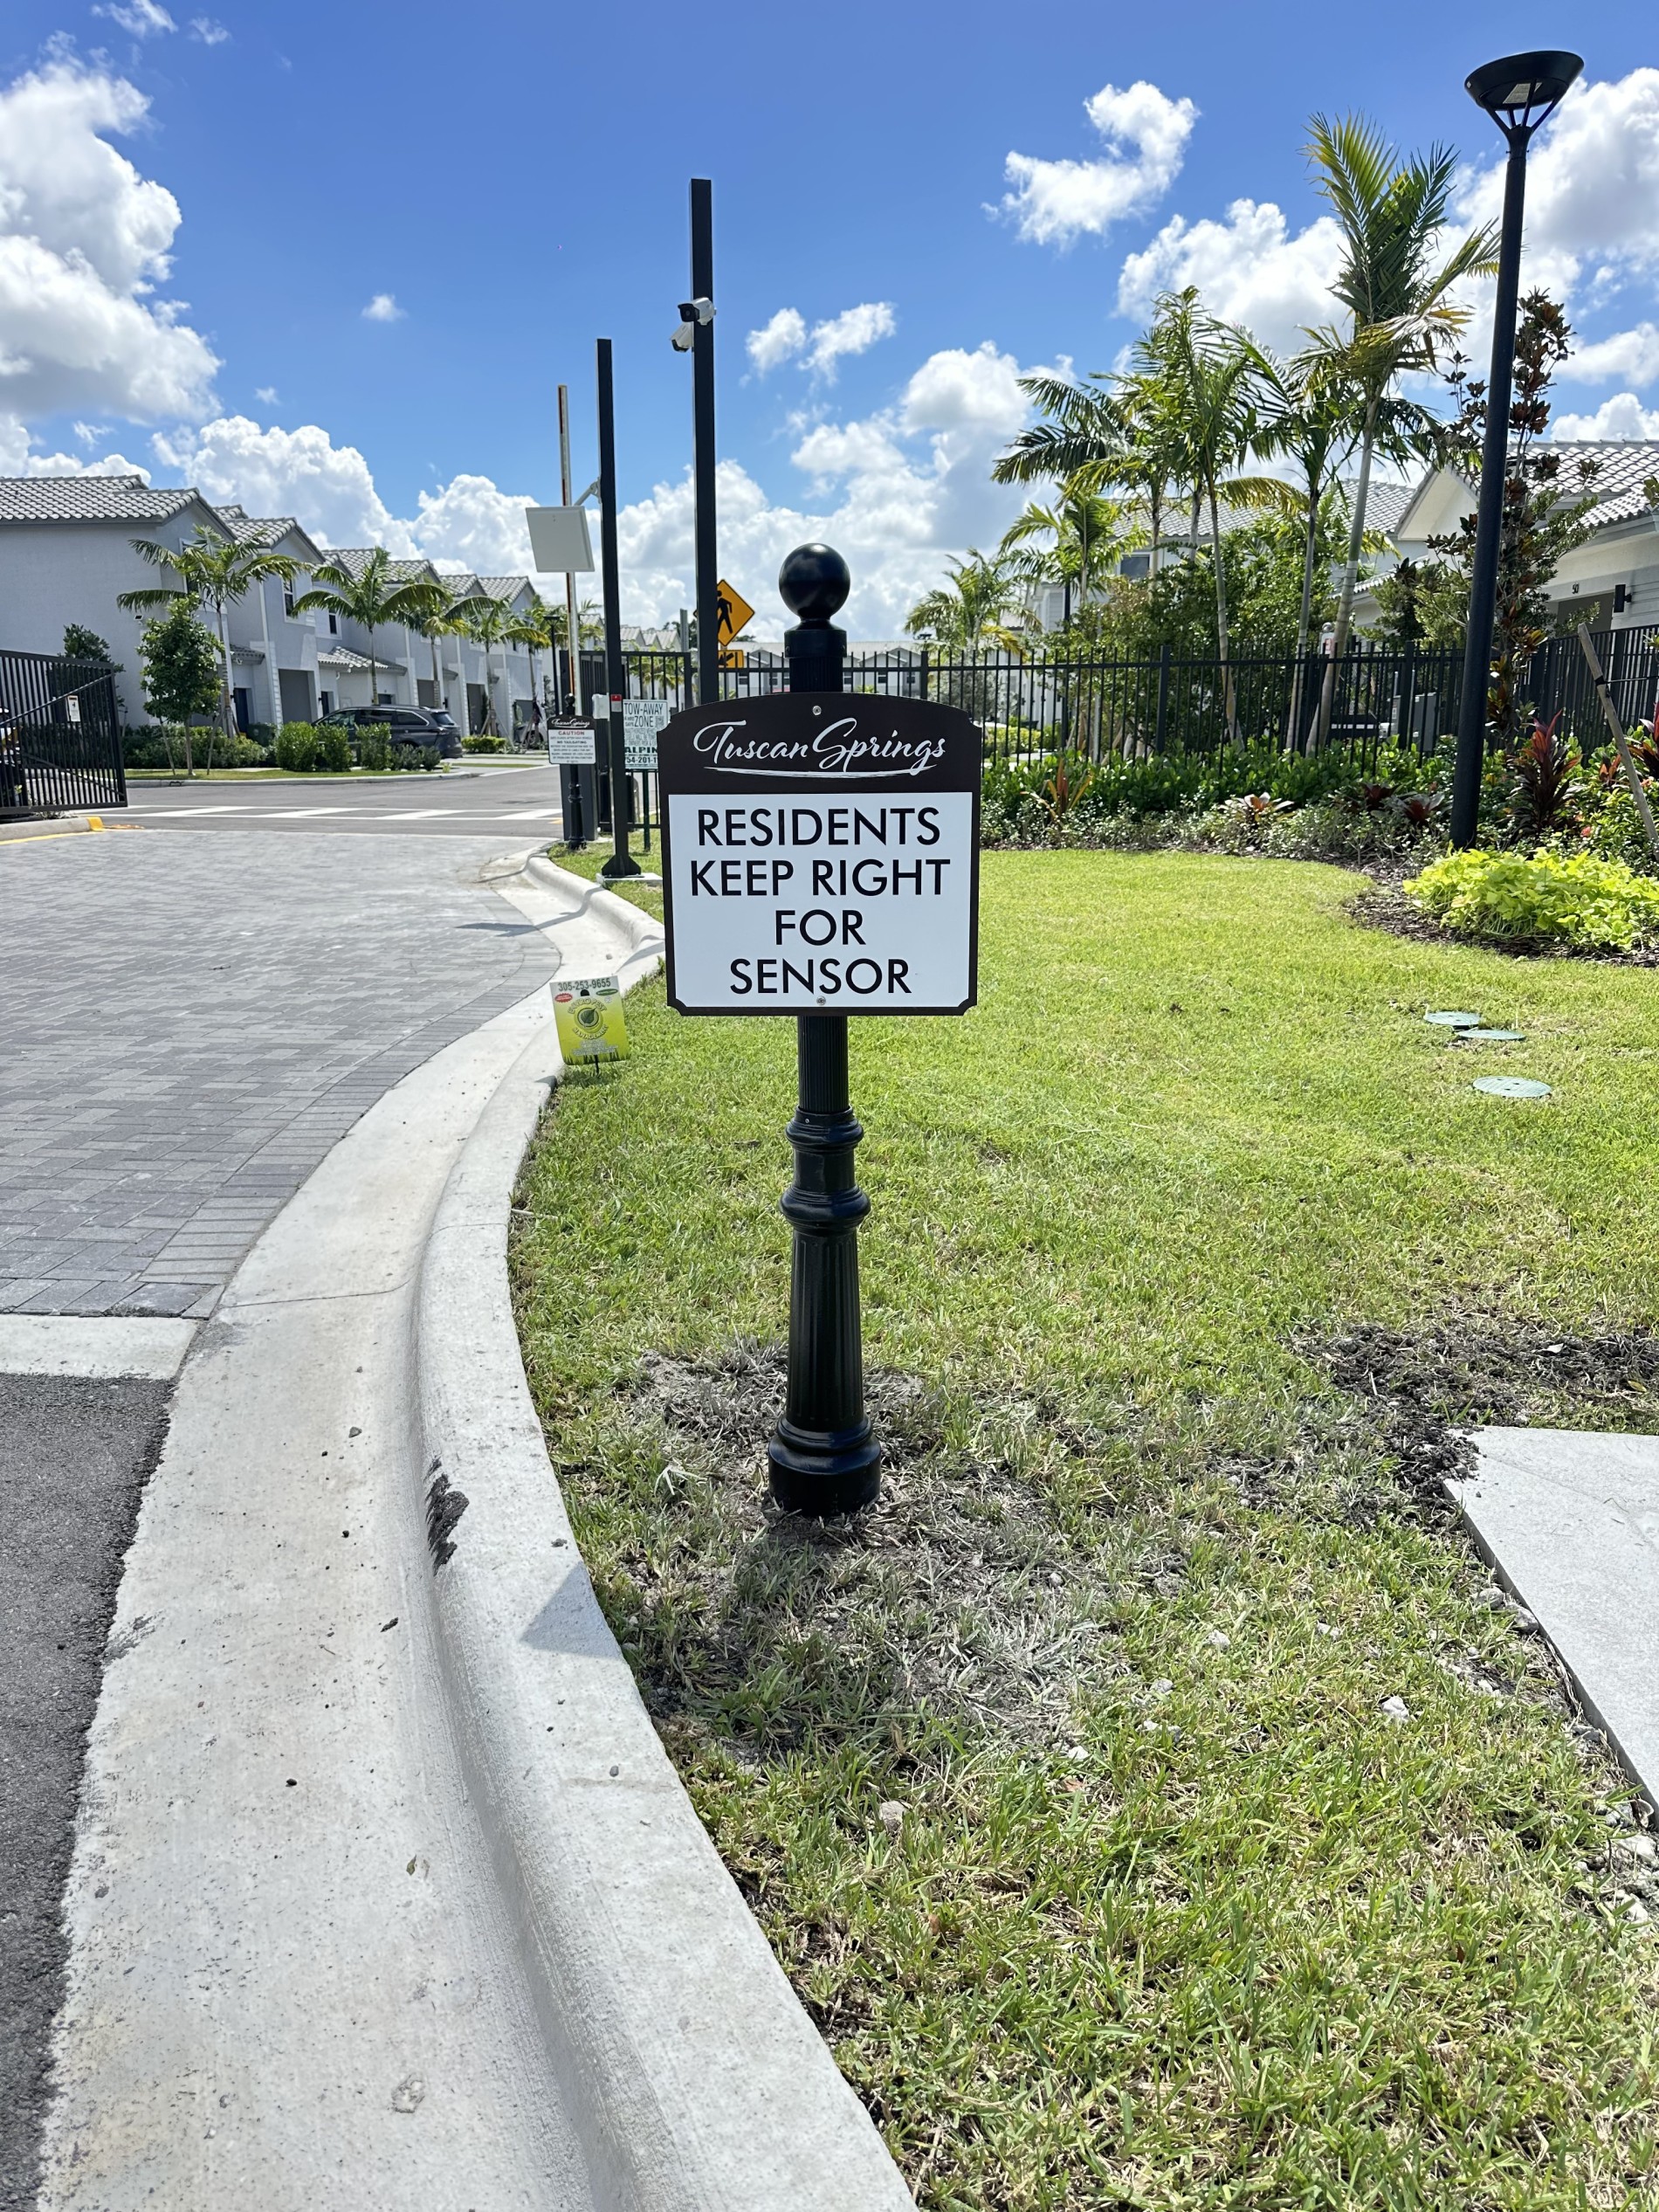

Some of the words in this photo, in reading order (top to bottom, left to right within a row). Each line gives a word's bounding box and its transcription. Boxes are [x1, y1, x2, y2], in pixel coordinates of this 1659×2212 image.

[624, 702, 663, 714] TOW-AWAY
[635, 715, 654, 727] ZONE
[693, 720, 808, 766] Tuscan
[812, 717, 947, 776] Springs
[698, 807, 940, 847] RESIDENTS
[691, 859, 794, 897] KEEP
[812, 858, 951, 897] RIGHT
[775, 909, 866, 946] FOR
[557, 977, 611, 992] 305-253-9655
[730, 958, 912, 995] SENSOR
